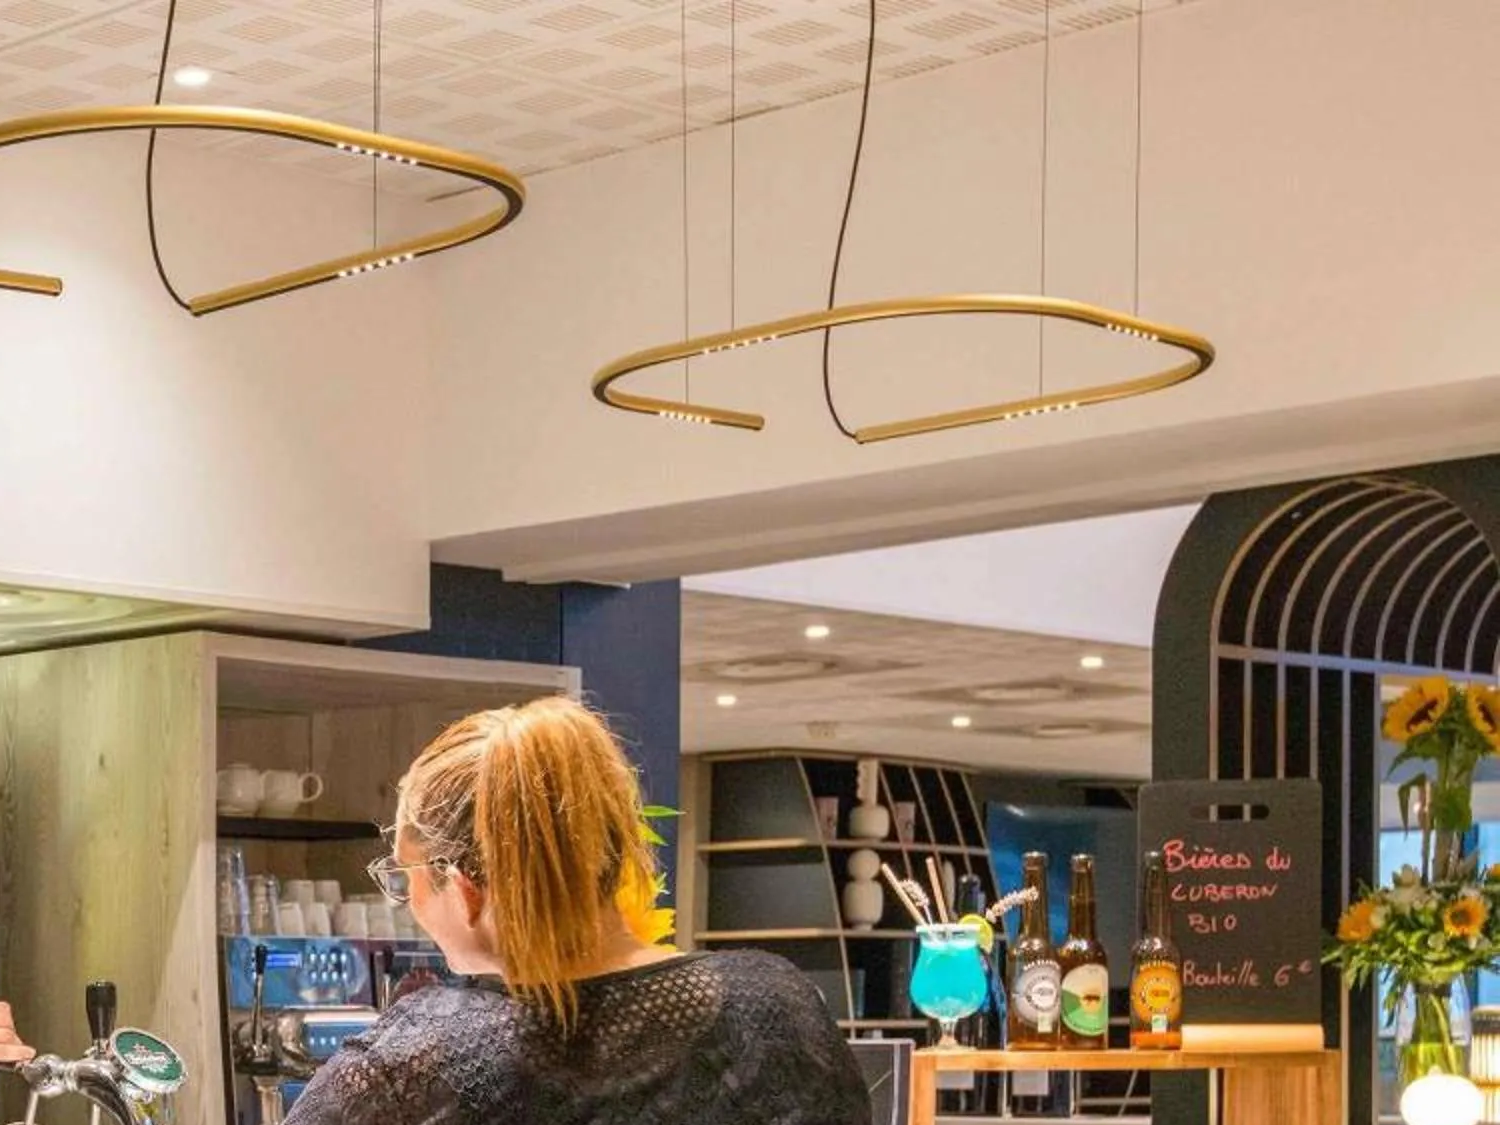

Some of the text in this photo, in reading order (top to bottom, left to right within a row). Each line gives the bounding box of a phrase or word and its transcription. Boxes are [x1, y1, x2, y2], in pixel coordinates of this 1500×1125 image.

[1265, 847, 1292, 871] du
[1188, 913, 1238, 934] BIO
[1183, 959, 1259, 987] Bouteille
